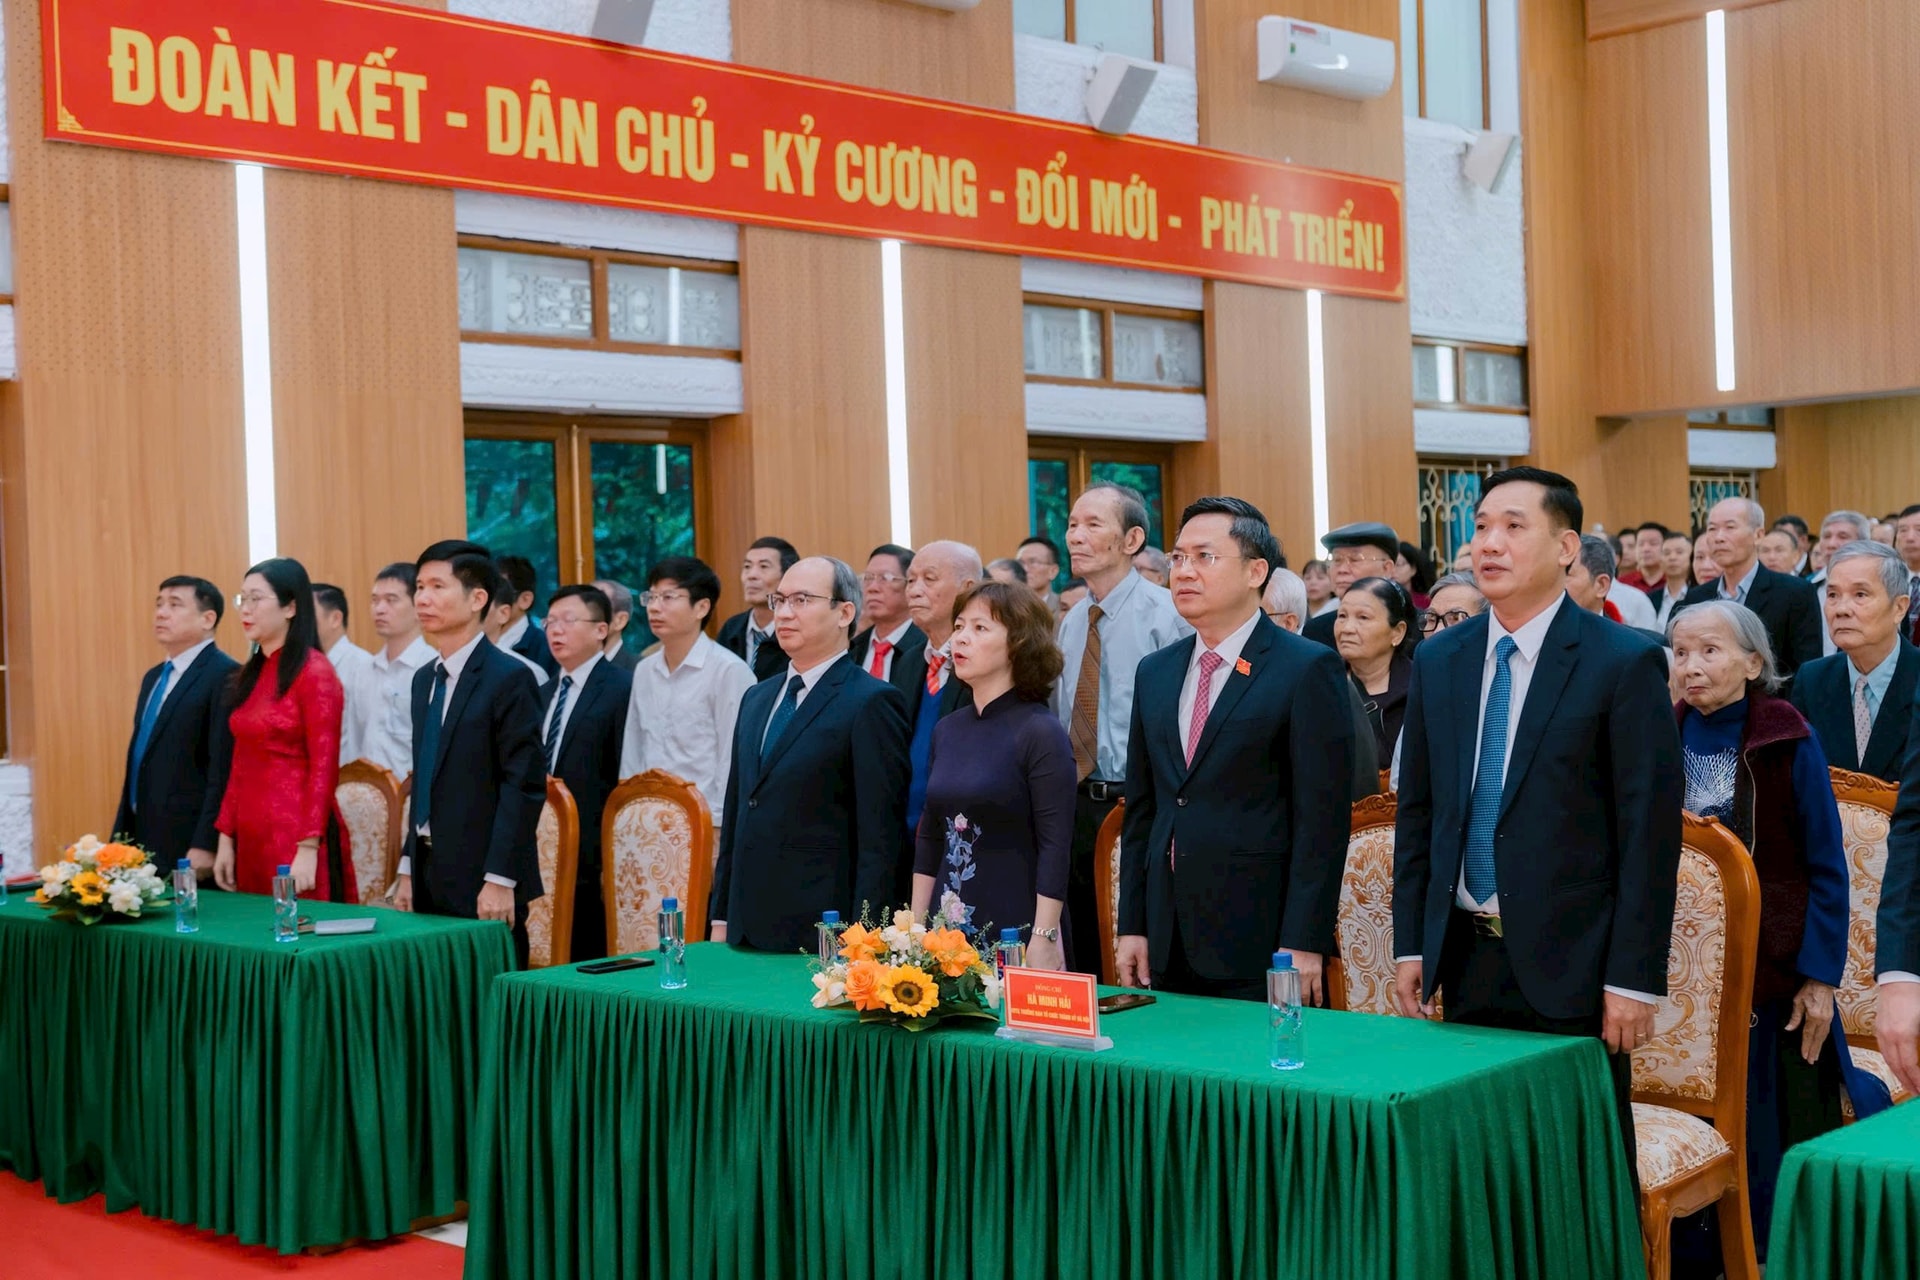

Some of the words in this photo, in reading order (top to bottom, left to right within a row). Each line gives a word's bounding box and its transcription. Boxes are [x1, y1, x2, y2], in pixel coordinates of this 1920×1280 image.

[108, 27, 296, 126] ĐOÀN
[317, 47, 427, 143] KẾT
[446, 112, 468, 129] -
[486, 79, 598, 167] DÂN
[616, 96, 715, 182] CHỦ
[731, 153, 748, 168] -
[763, 114, 821, 196] KỶ
[835, 141, 978, 218] CƯƠNG
[990, 190, 1005, 203] -
[1016, 151, 1079, 230] ĐỔI
[1091, 173, 1158, 241] MỚI
[1169, 216, 1181, 228] -
[1201, 195, 1282, 257] PHÁT
[1290, 200, 1385, 273] TRIỂN!
[1039, 995, 1057, 1007] MINH
